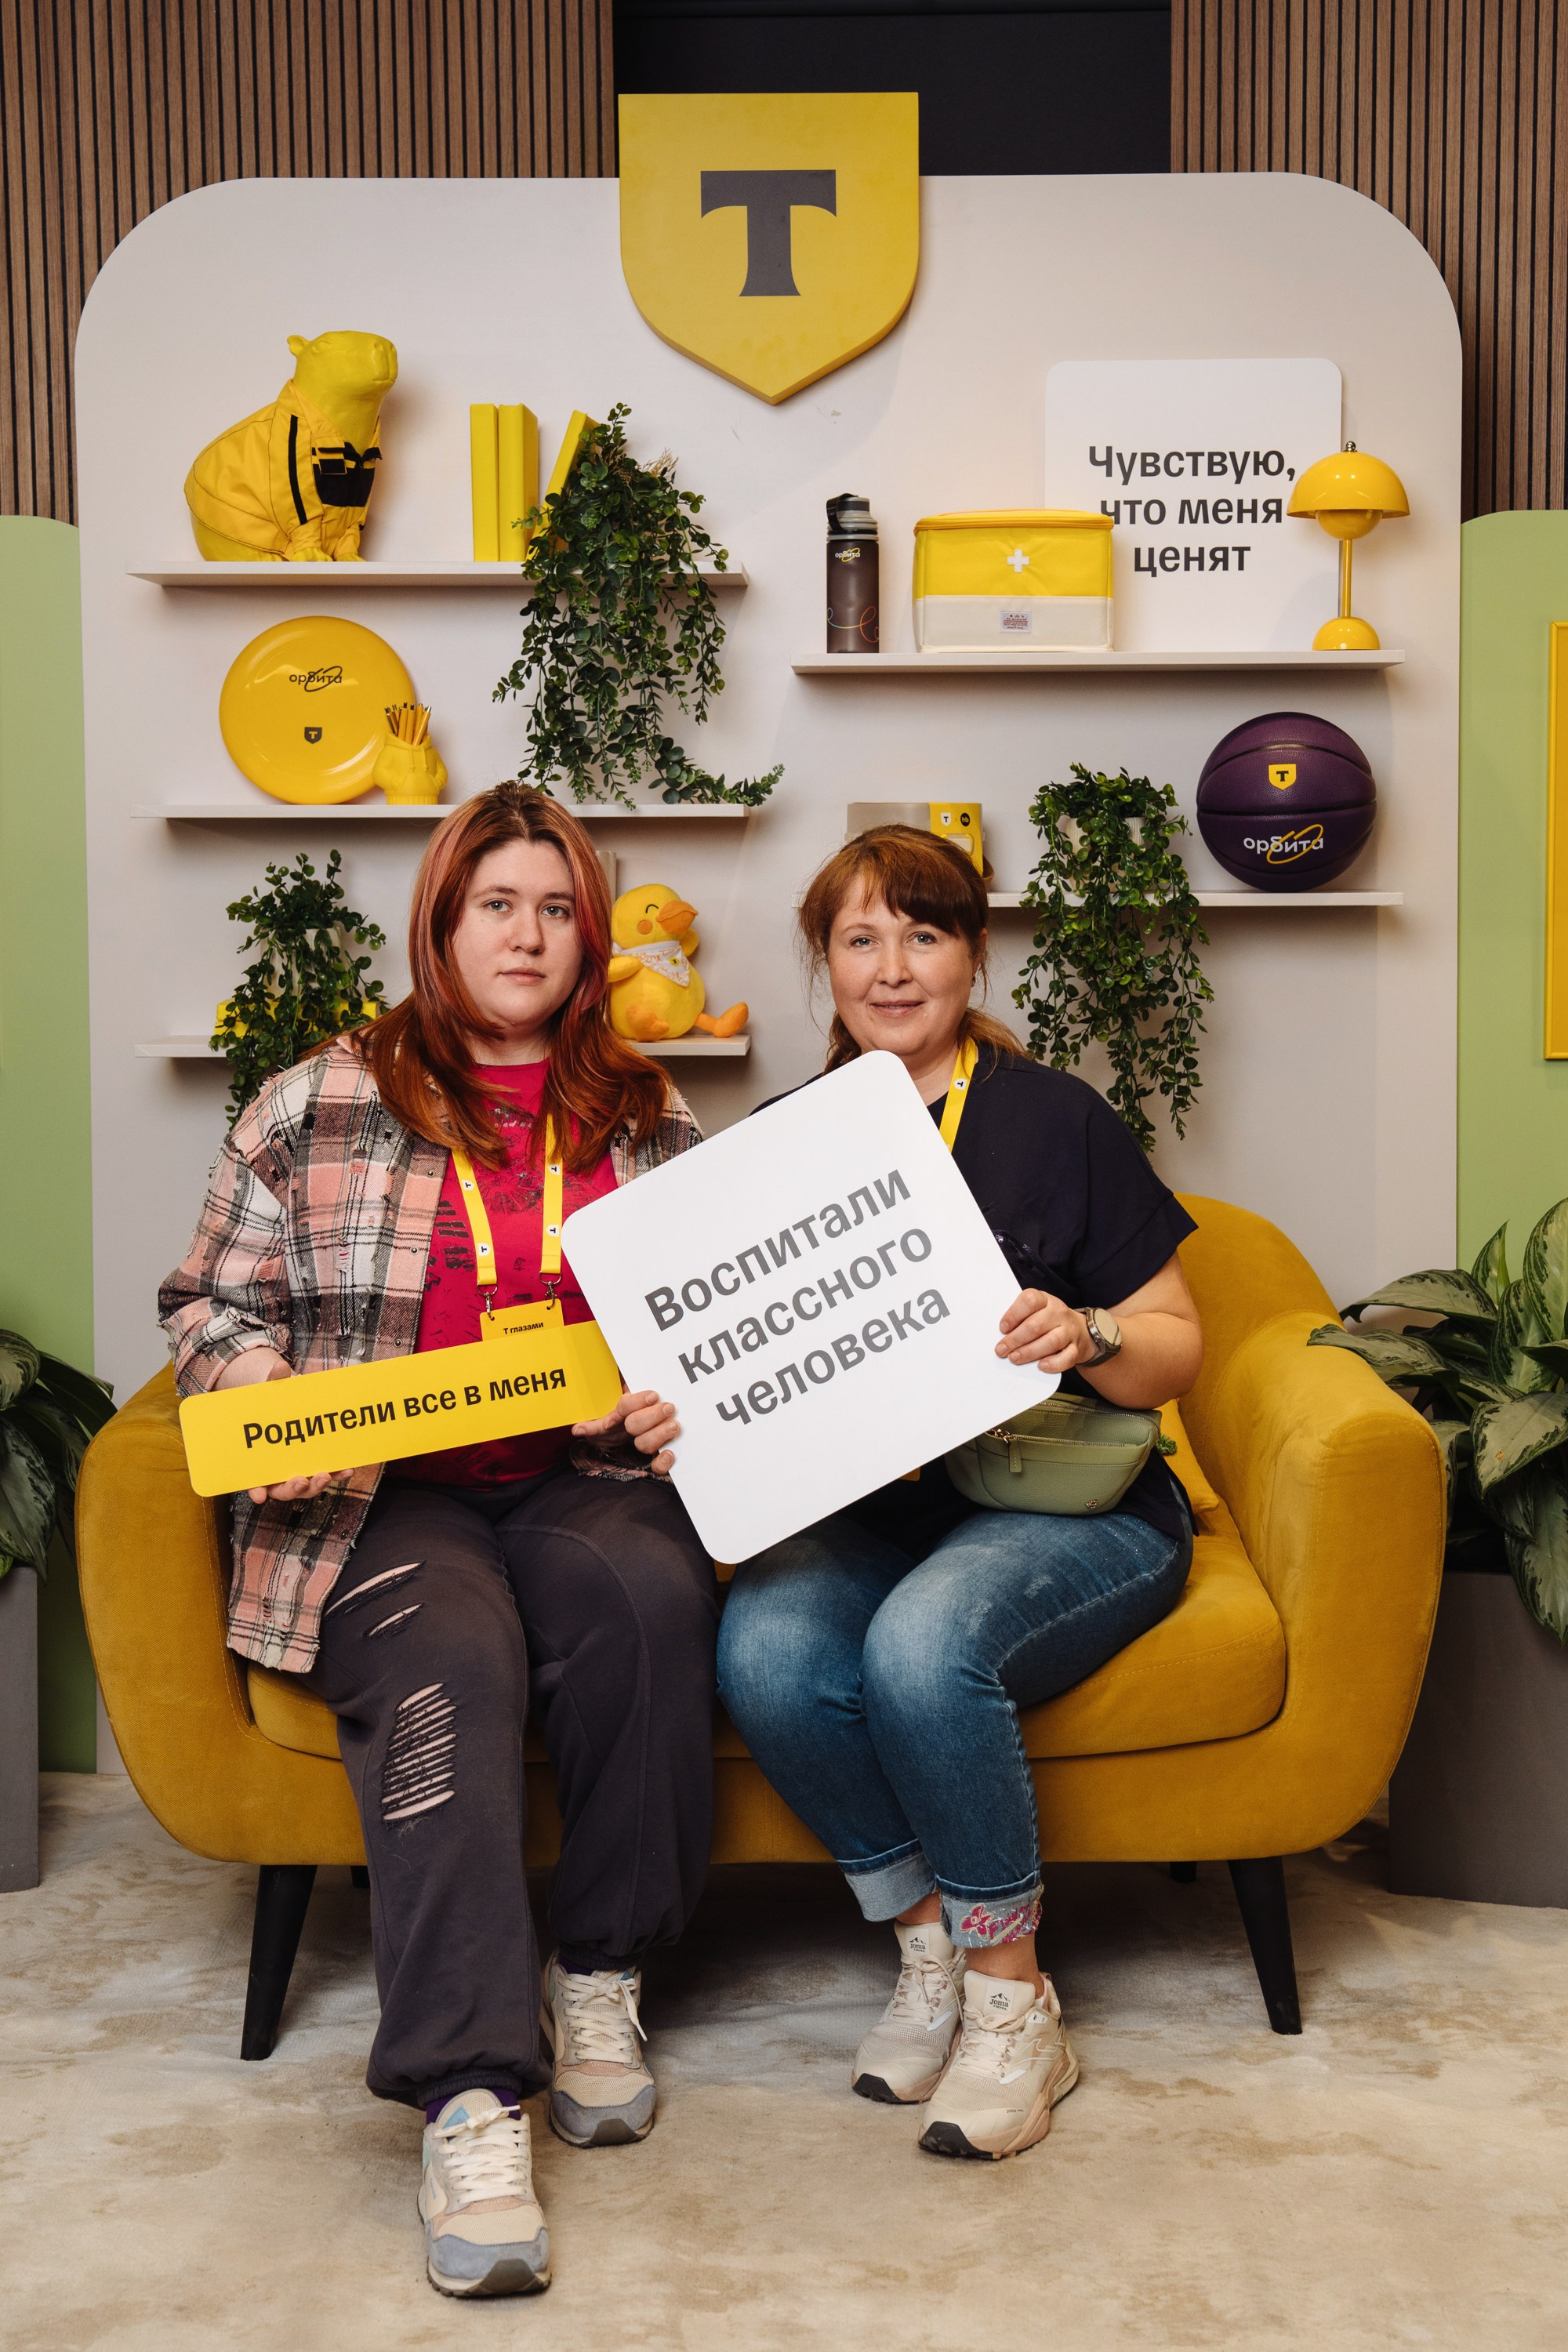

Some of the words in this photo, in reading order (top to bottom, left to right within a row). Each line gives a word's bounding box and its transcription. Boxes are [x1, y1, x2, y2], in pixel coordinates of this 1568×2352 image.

[700, 169, 837, 296] Т
[1089, 445, 1296, 486] Чувствую,
[1100, 499, 1167, 525] что
[1178, 498, 1283, 524] меня
[834, 550, 861, 560] орбита
[1134, 546, 1251, 578] ценят
[289, 670, 343, 687] орбита
[1243, 834, 1324, 855] орбита
[644, 1168, 912, 1332] Воспитали
[677, 1228, 933, 1385] классного
[510, 1322, 544, 1334] глазами
[715, 1288, 951, 1426] человека
[243, 1400, 396, 1449] Родители
[403, 1388, 458, 1418] все
[463, 1384, 482, 1406] в
[489, 1367, 568, 1402] меня
